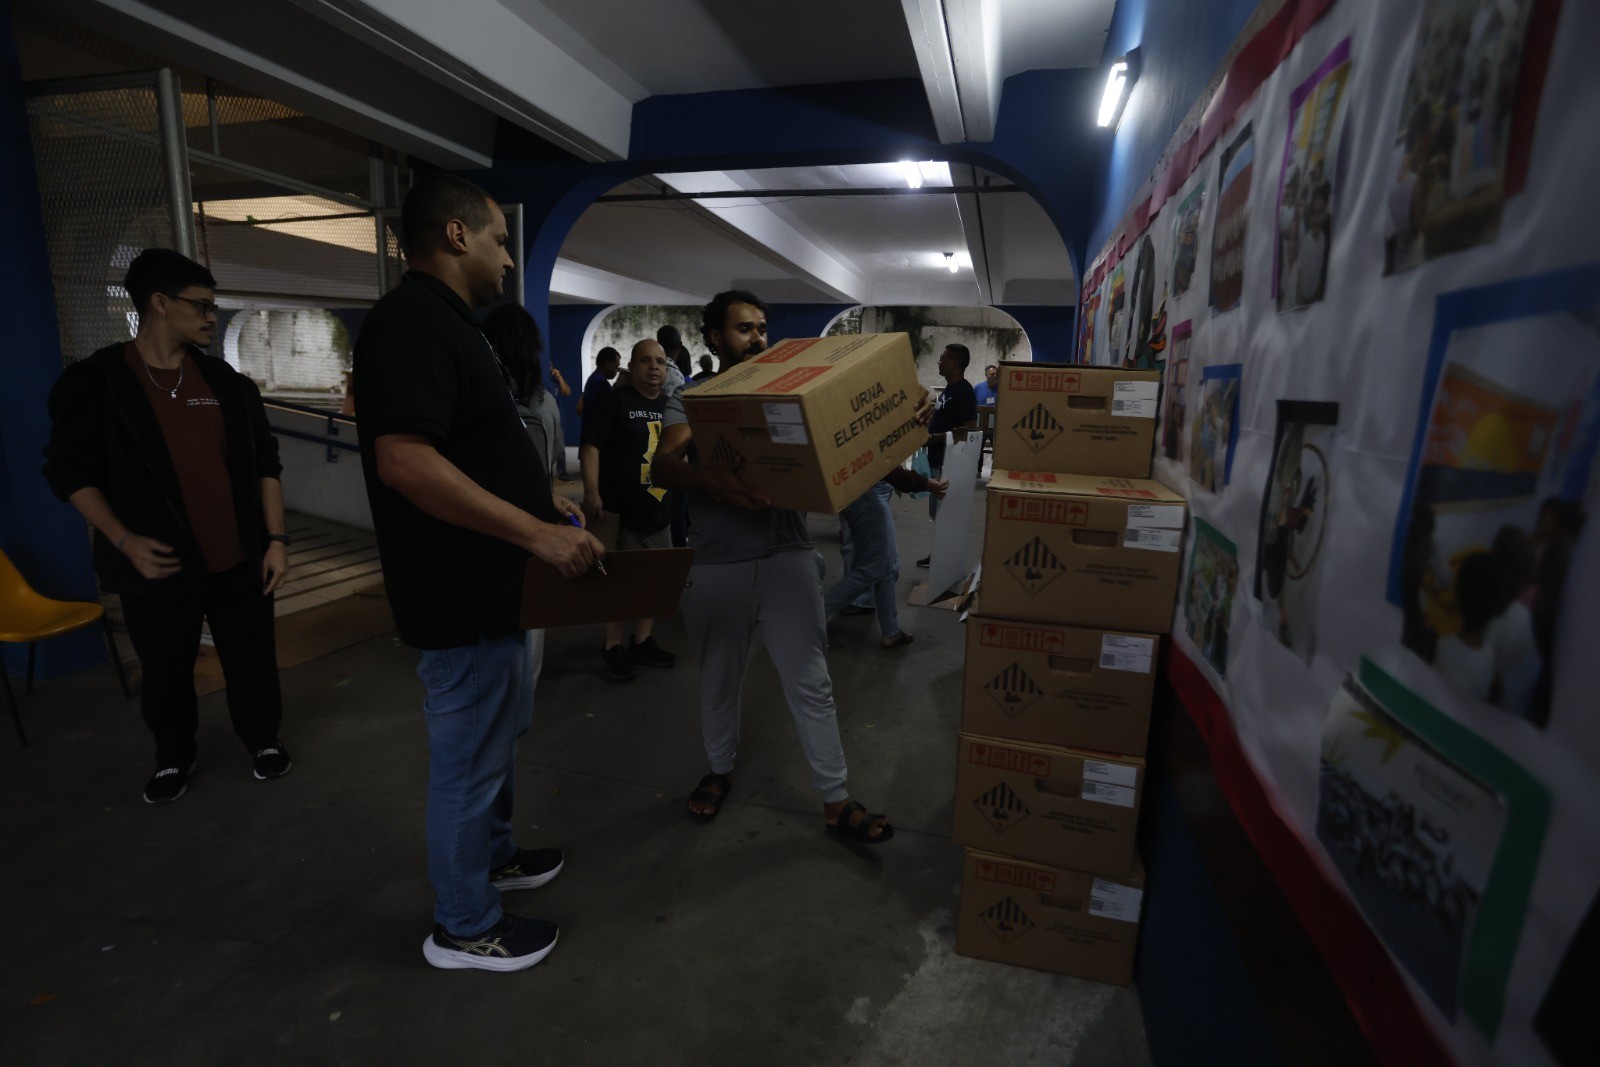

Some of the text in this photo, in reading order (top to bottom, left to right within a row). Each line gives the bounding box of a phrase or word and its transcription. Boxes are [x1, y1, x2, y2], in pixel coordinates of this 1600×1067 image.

[629, 411, 663, 420] DIRE STR
[834, 389, 907, 448] ELETRÔNICA
[850, 382, 885, 412] URNA
[832, 416, 918, 486] UE 2020 POSITIV
